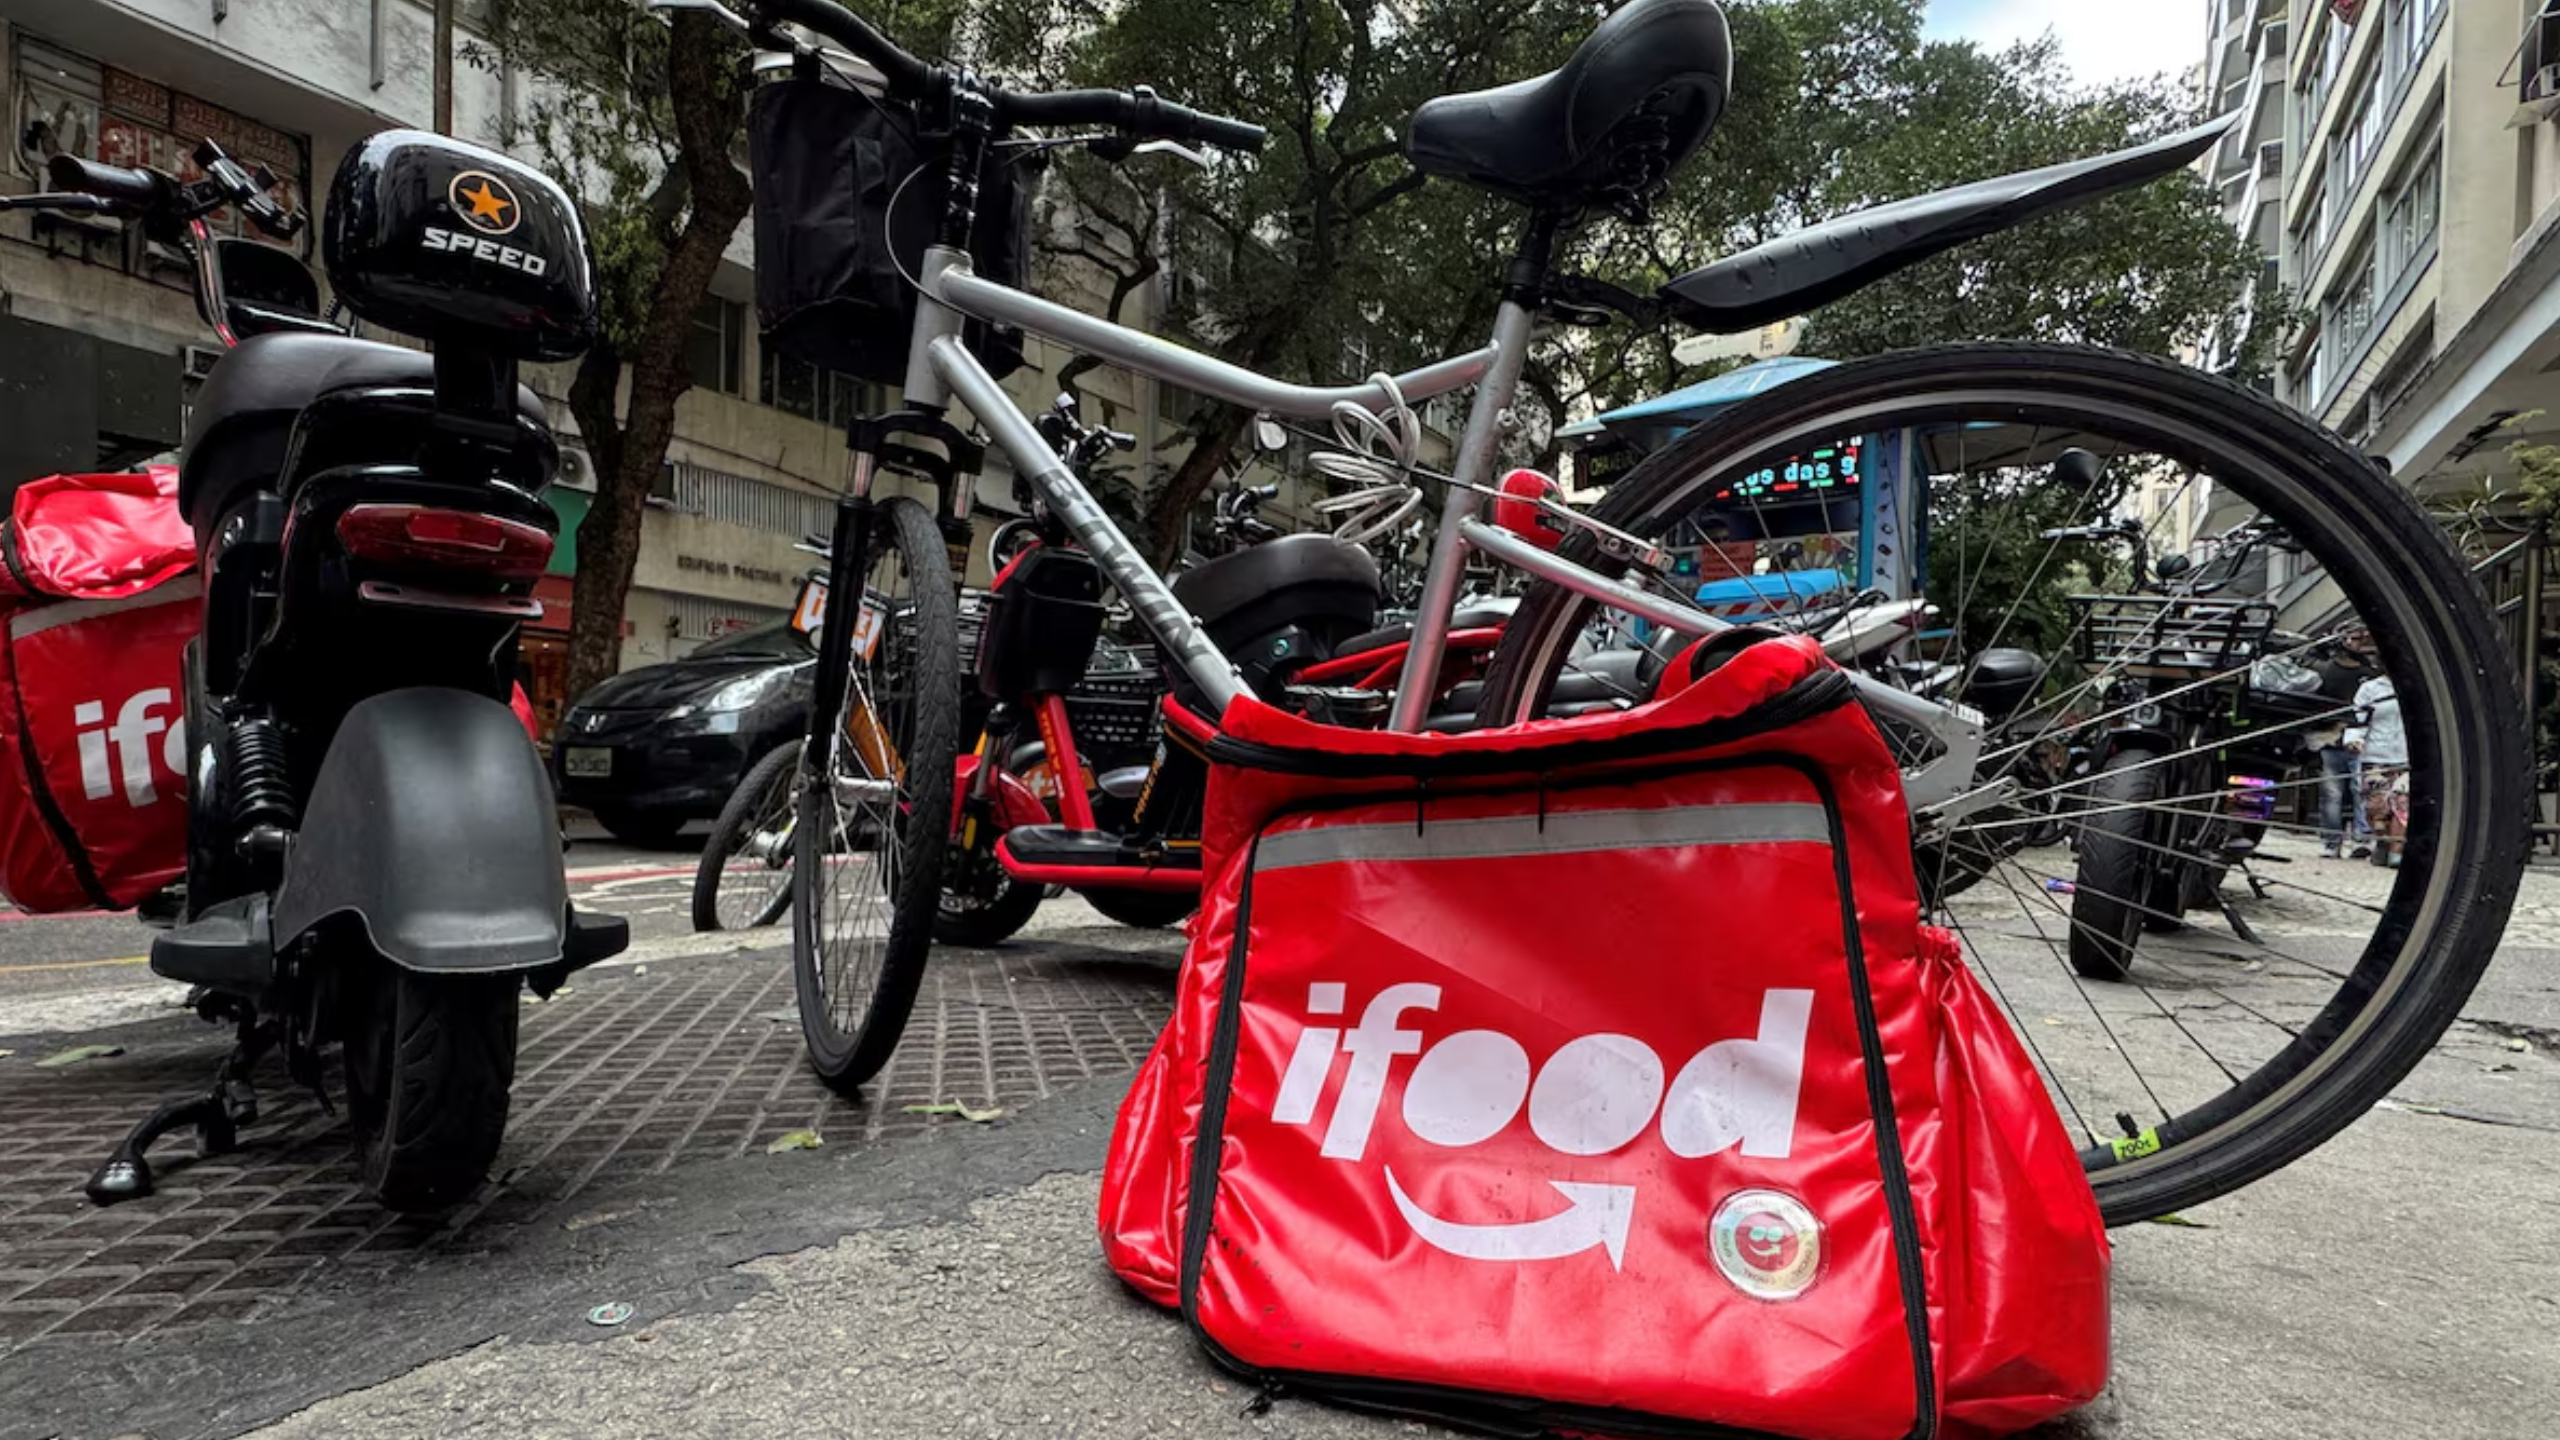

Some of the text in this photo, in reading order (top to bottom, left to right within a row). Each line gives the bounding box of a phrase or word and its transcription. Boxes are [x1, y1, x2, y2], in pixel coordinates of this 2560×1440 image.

[421, 226, 547, 276] SPEED
[1784, 460, 1831, 483] das
[1271, 981, 1815, 1161] ifood
